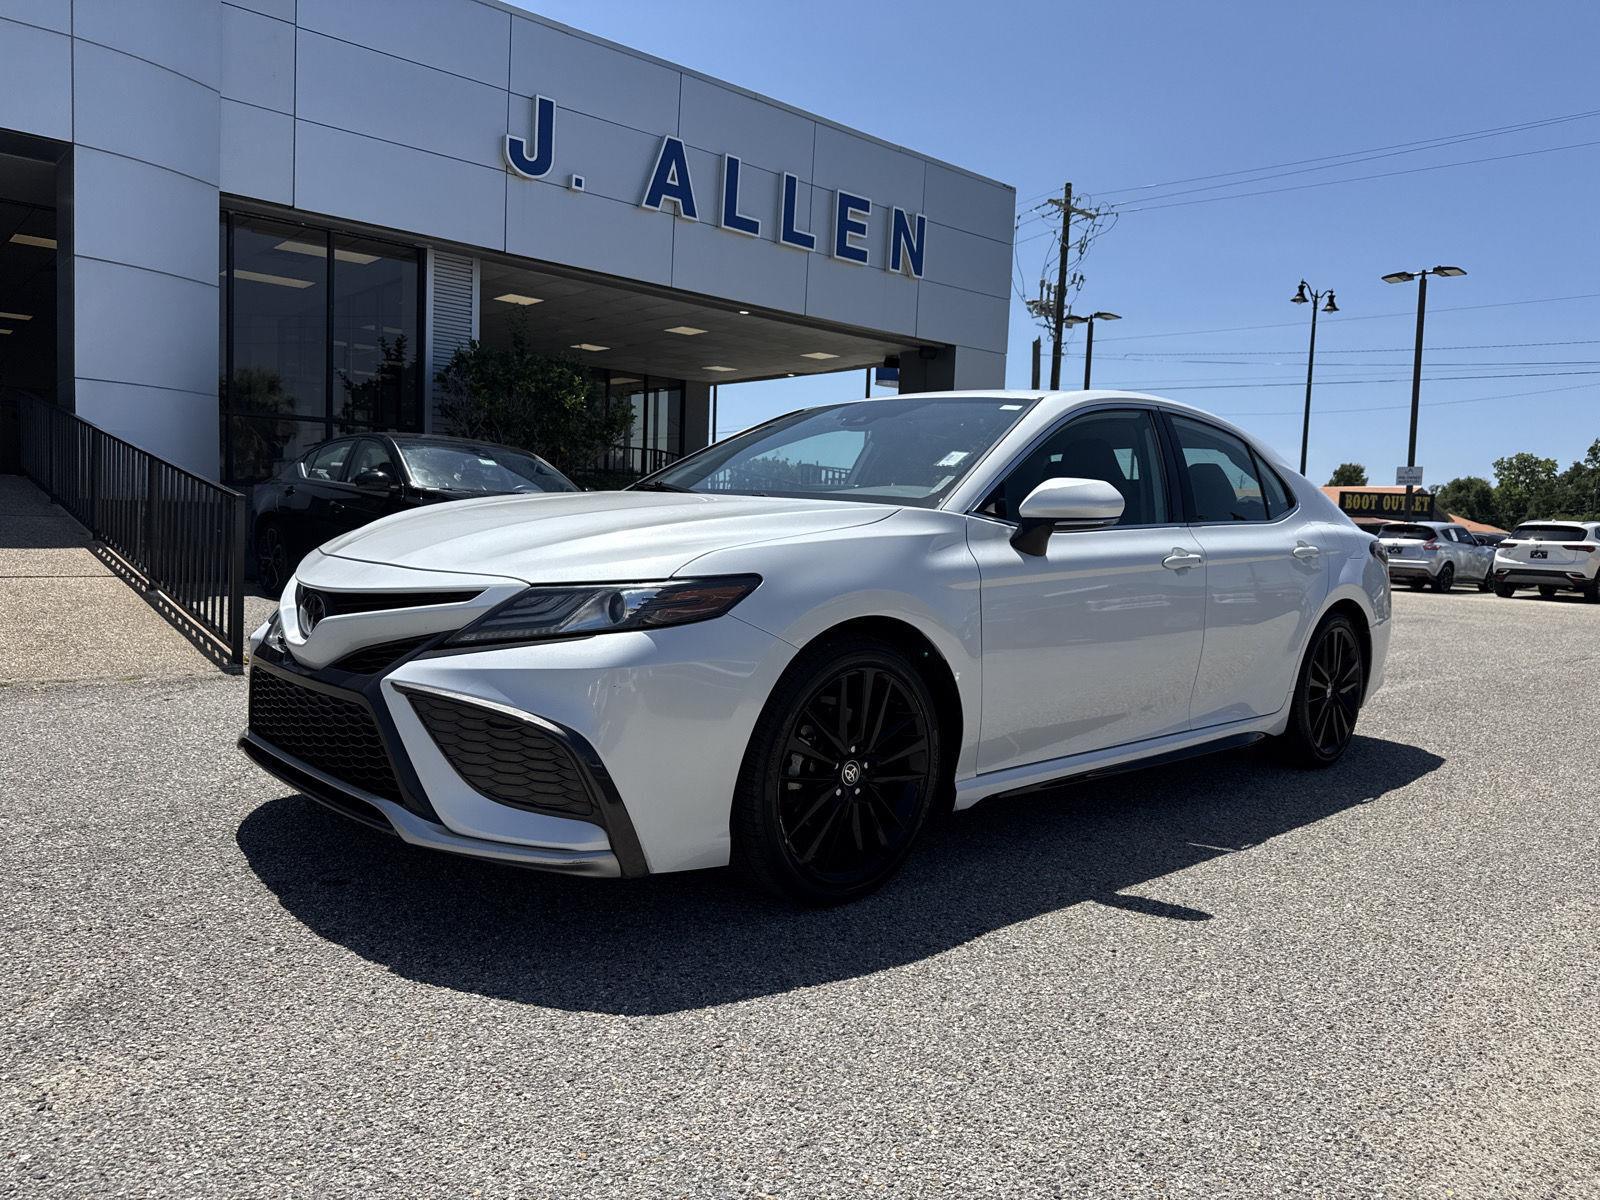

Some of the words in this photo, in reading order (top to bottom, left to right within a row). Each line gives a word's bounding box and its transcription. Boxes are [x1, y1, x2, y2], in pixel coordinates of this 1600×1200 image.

[503, 94, 585, 191] J.
[641, 134, 928, 279] ALLEN
[1345, 494, 1378, 510] BOOT
[1383, 495, 1430, 511] OUTET
